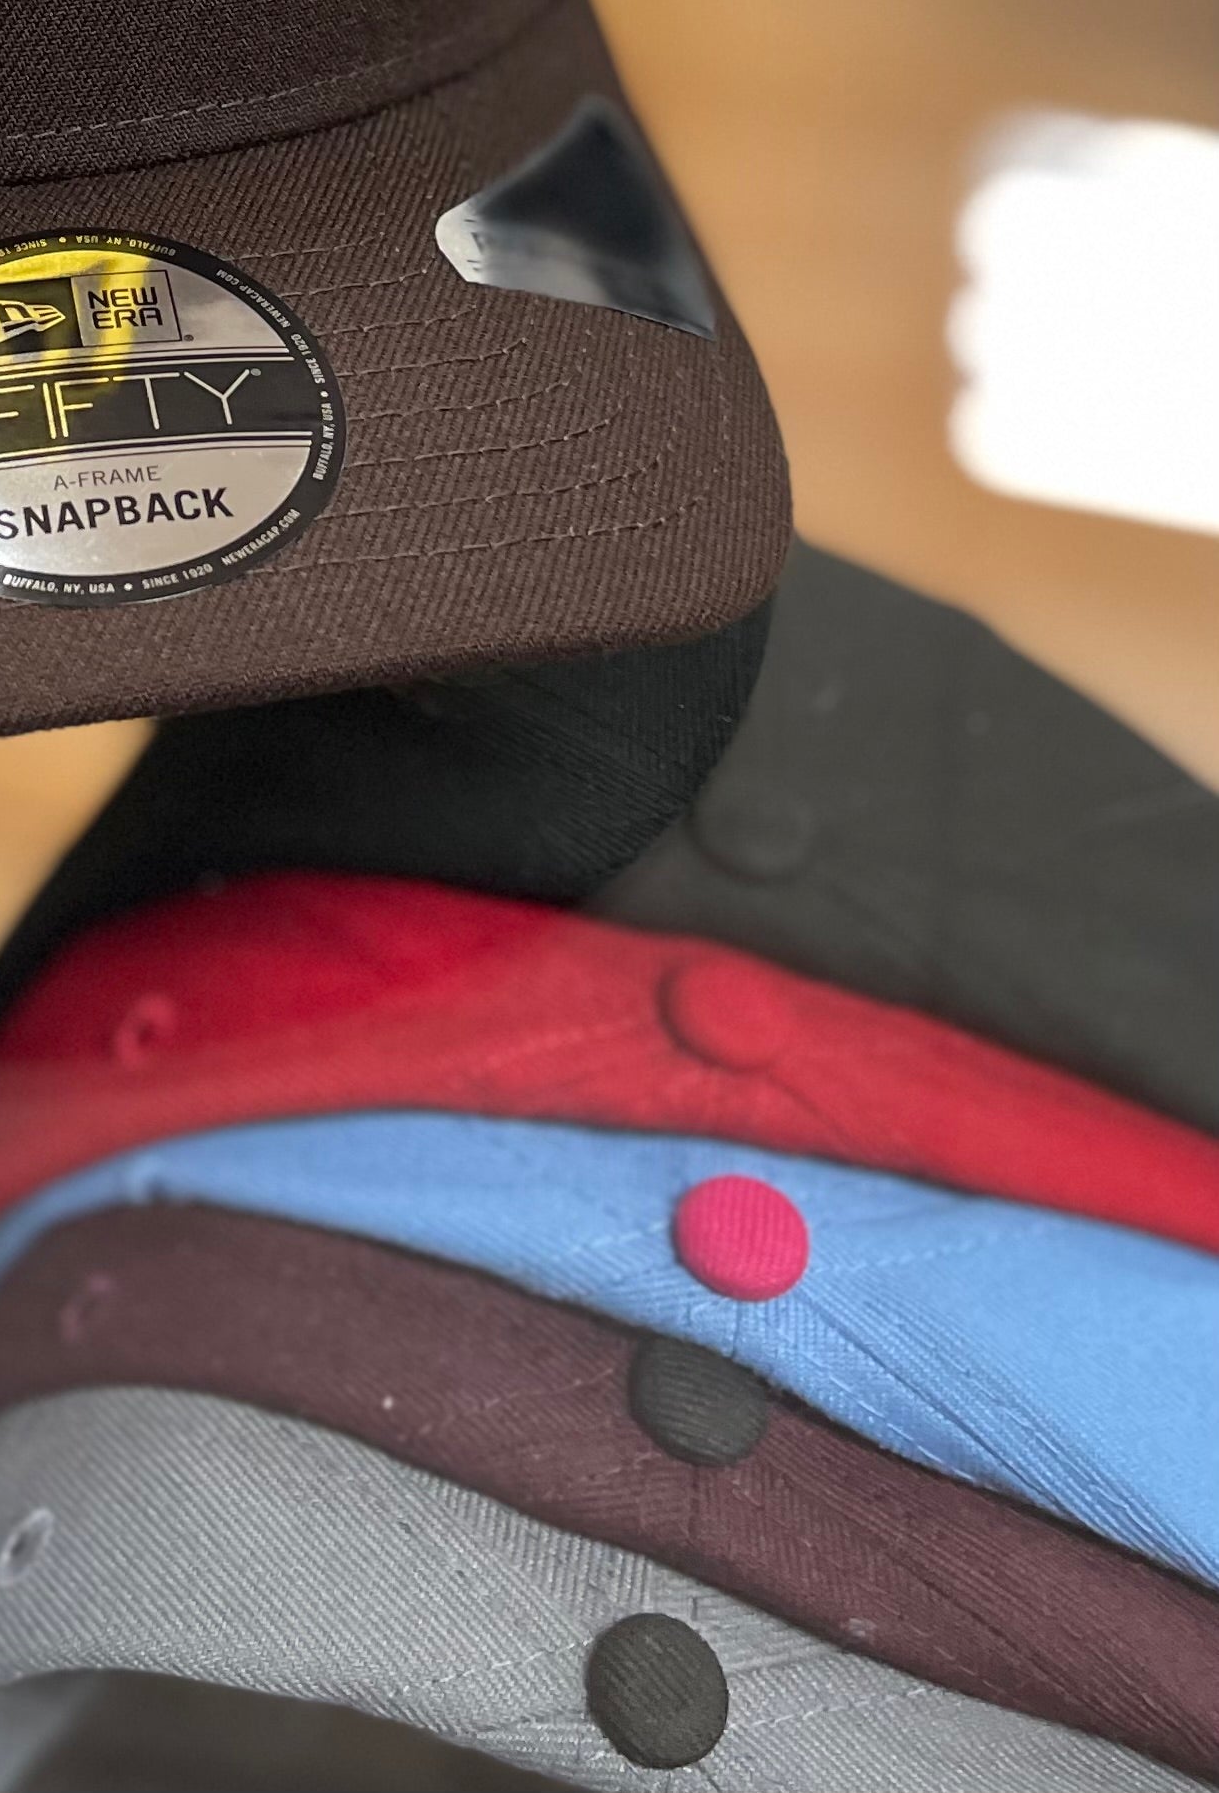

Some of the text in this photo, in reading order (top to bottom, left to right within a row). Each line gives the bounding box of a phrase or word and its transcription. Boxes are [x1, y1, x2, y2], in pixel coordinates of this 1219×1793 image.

[13, 238, 48, 253] SINCE
[76, 235, 99, 245] USA
[87, 286, 158, 309] NEW
[92, 307, 163, 329] ERA
[290, 333, 312, 356] 1920
[305, 357, 326, 384] SINCE
[321, 402, 334, 421] USA
[53, 465, 162, 491] A-FRAME
[88, 582, 115, 595] USA
[141, 573, 179, 590] SINCE
[182, 563, 214, 580] 1920
